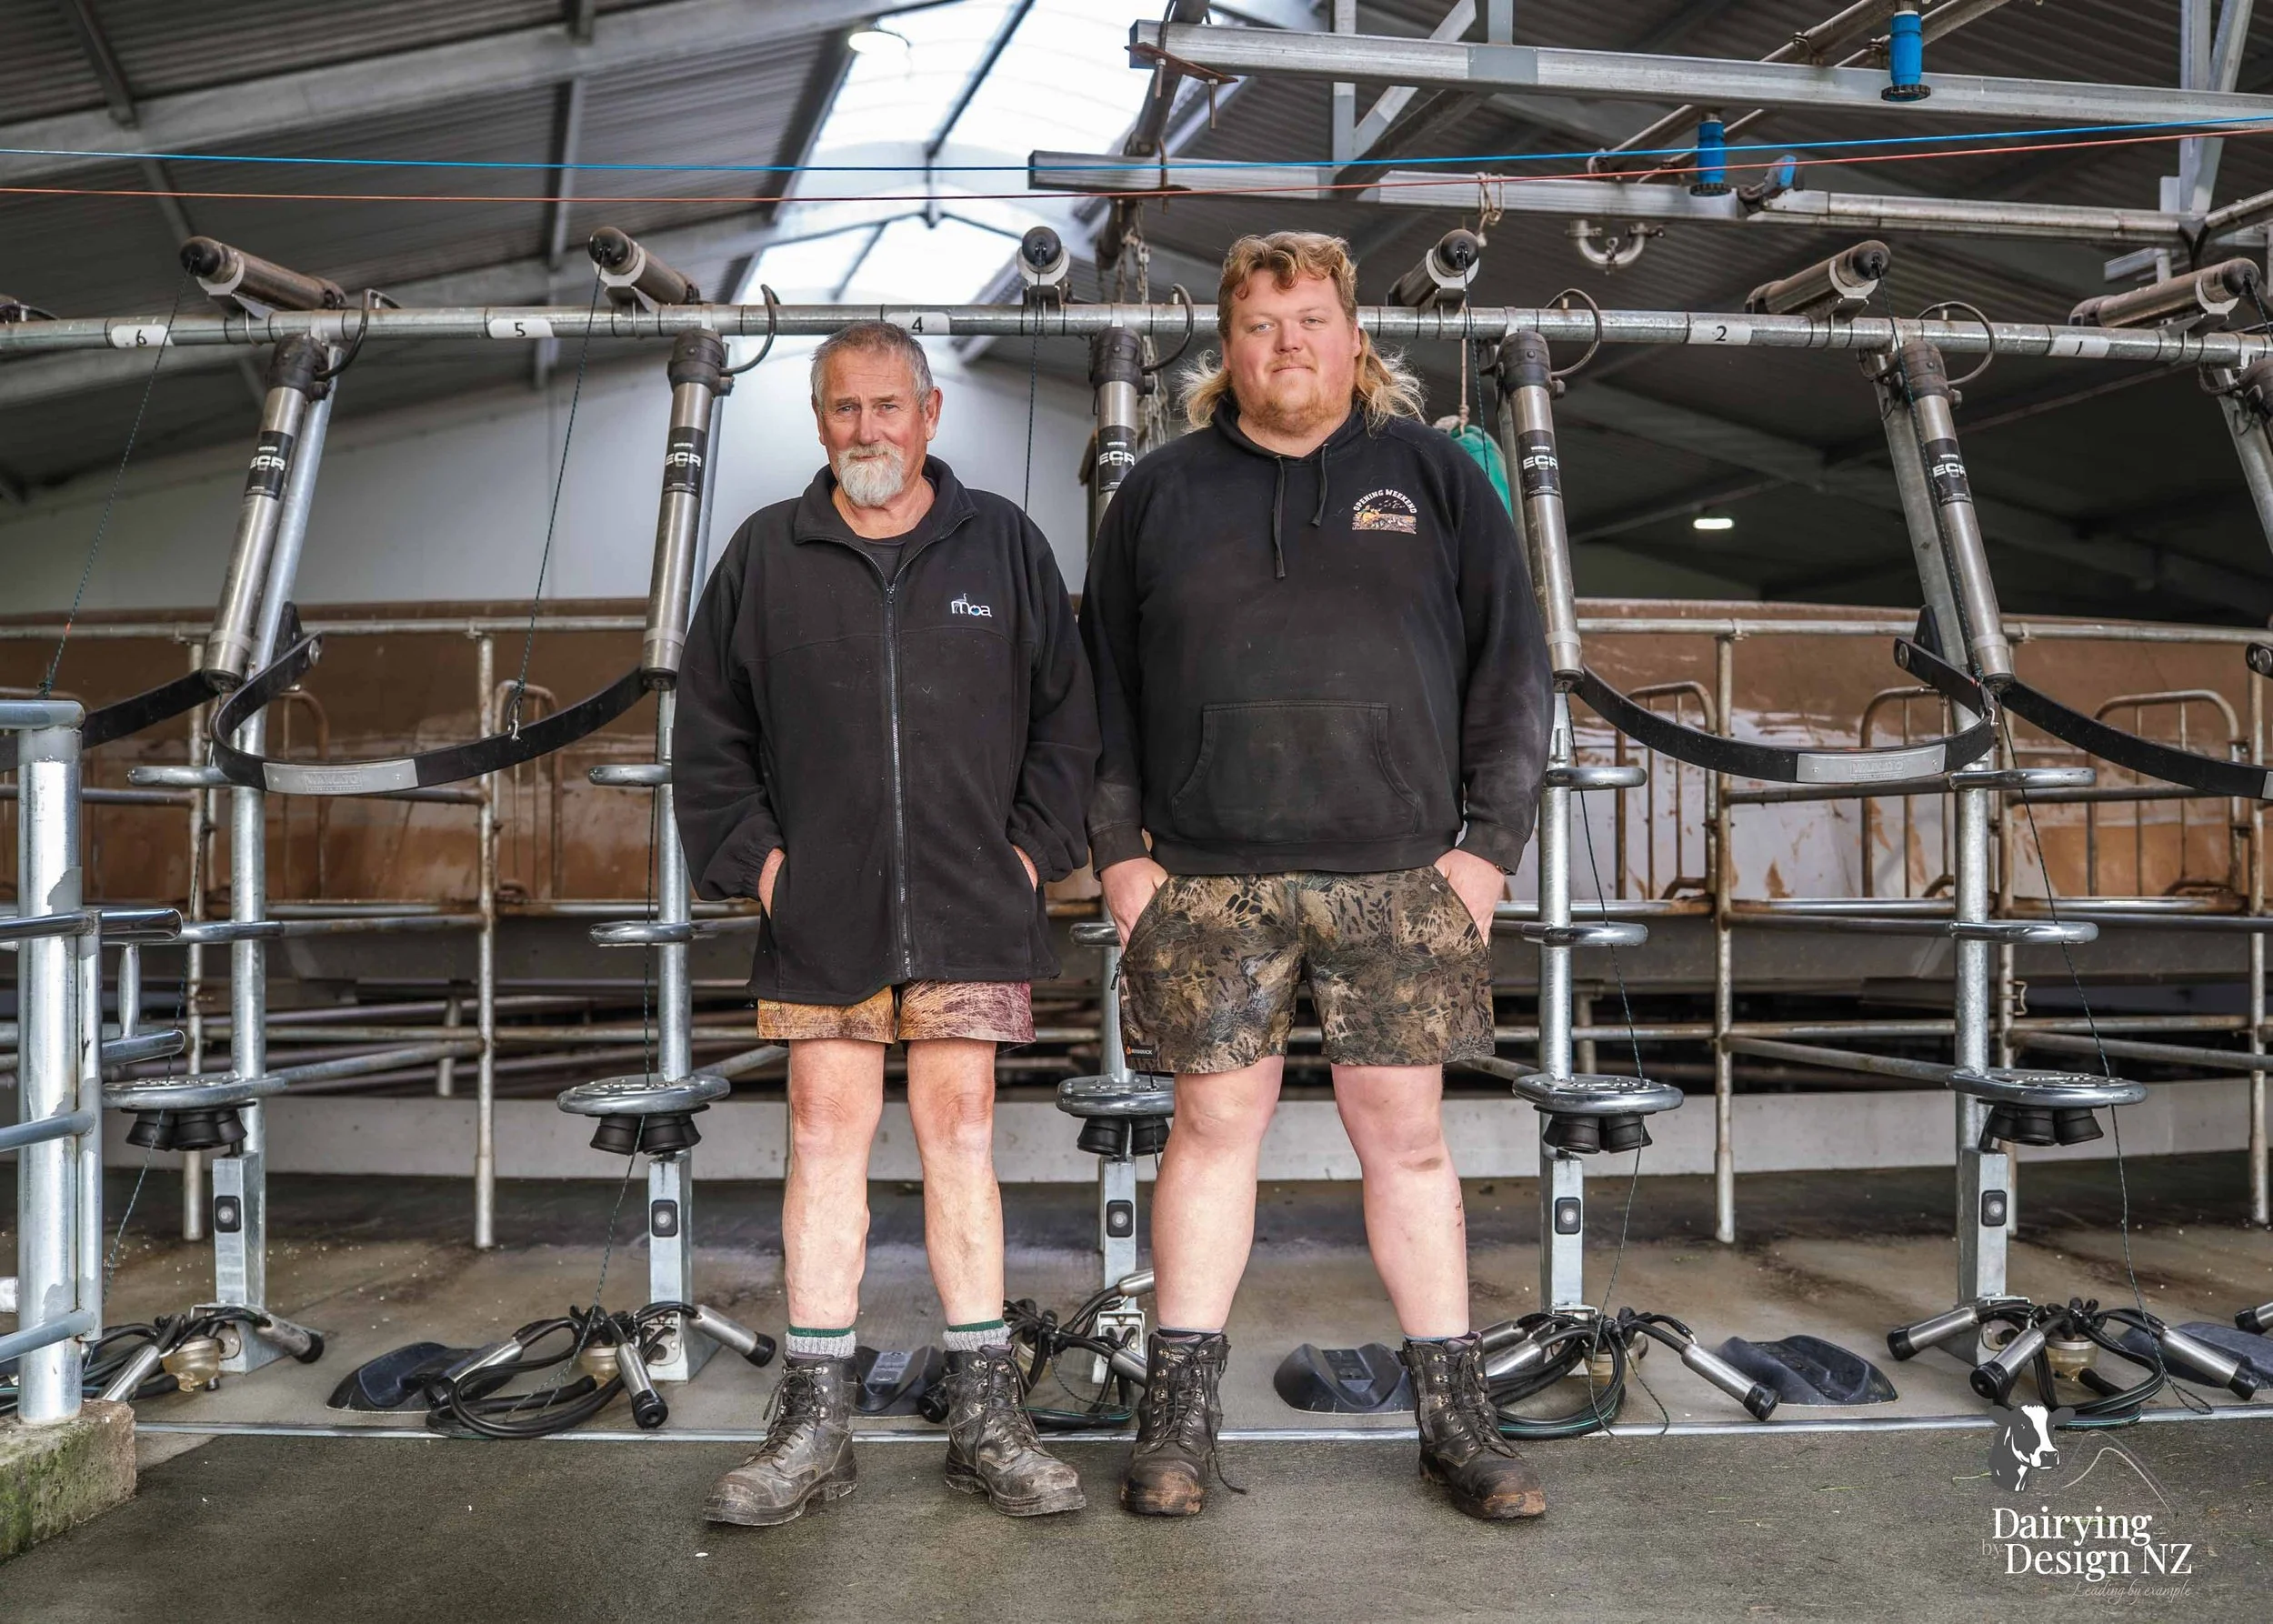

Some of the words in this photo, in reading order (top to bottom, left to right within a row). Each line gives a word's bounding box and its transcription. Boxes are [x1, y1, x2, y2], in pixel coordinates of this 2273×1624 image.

[515, 322, 526, 337] 5
[912, 316, 924, 333] 4
[135, 329, 147, 345] 6
[1715, 325, 1727, 342] 2
[2075, 340, 2083, 356] 1
[666, 452, 702, 467] ECR
[1099, 450, 1136, 466] ECR
[1523, 455, 1558, 470] ECR
[1353, 489, 1384, 511] OPENING
[1385, 488, 1417, 514] WEEKEND
[951, 597, 992, 617] moa
